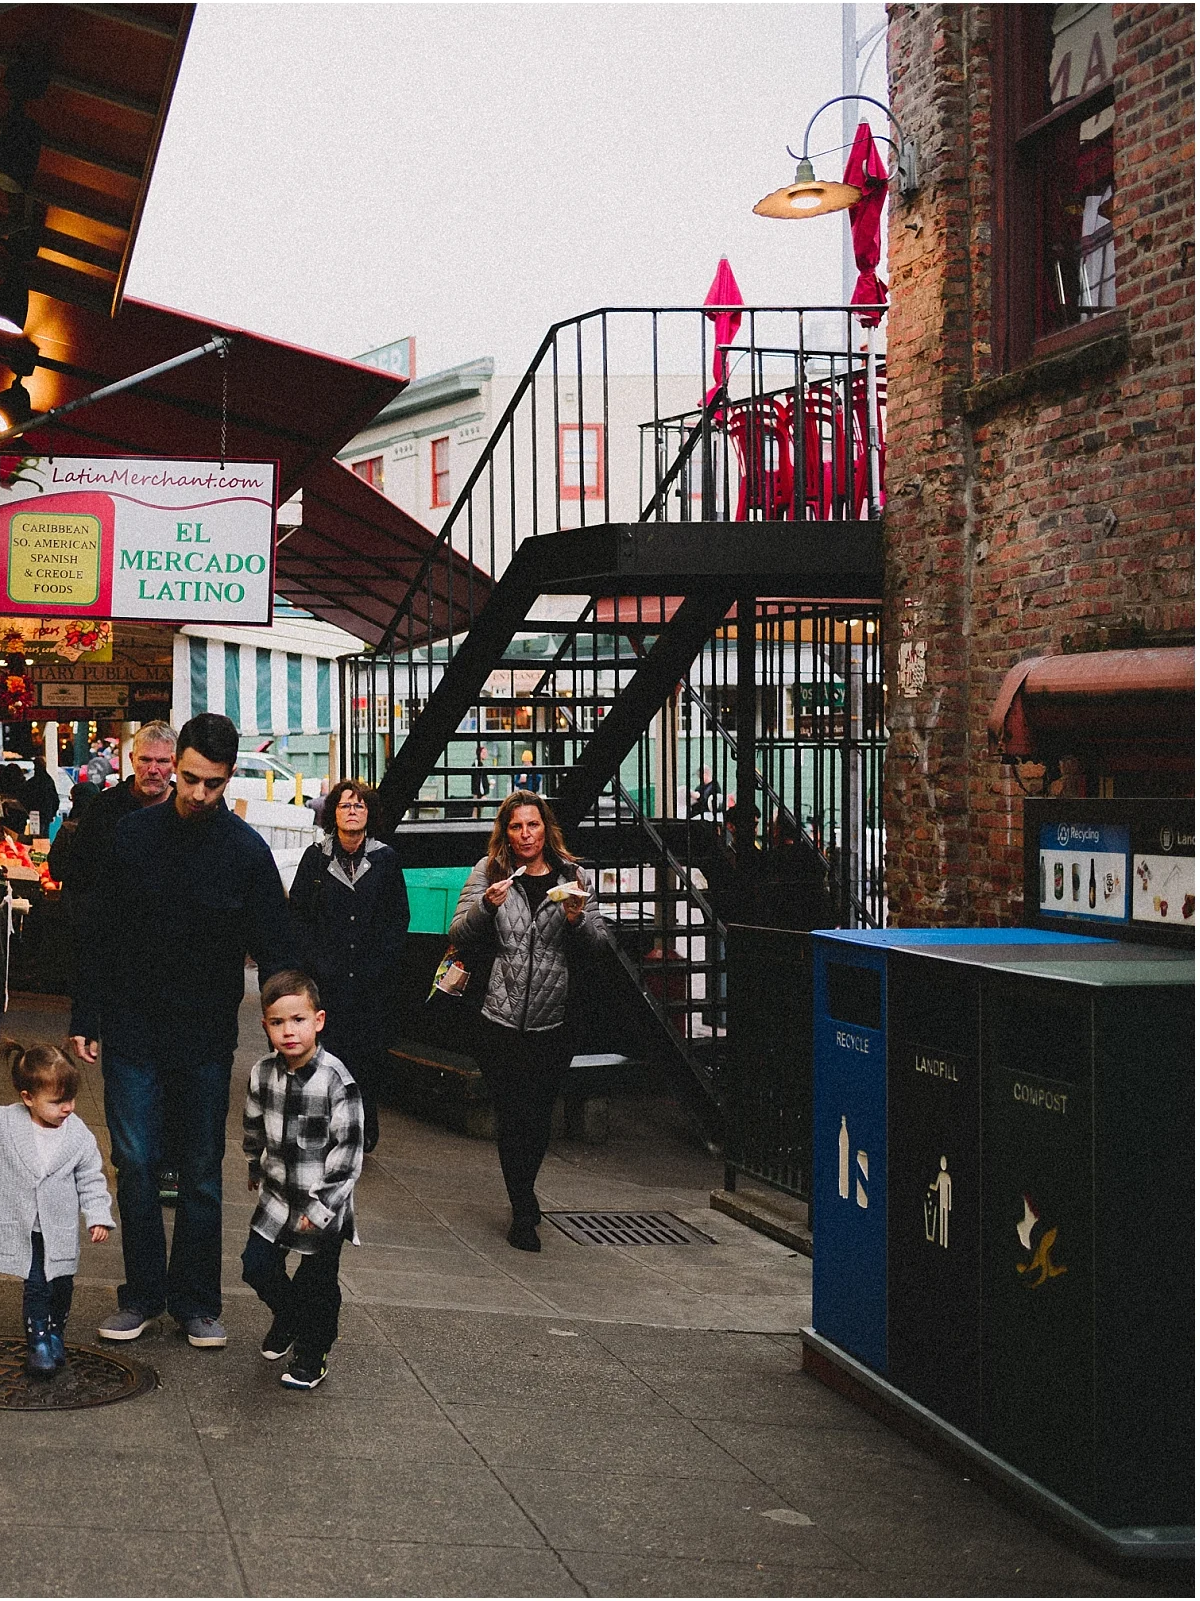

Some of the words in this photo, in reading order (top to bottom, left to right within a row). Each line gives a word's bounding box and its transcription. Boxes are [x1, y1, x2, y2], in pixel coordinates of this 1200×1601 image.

[52, 467, 264, 489] LatinMerchant.com
[22, 523, 89, 534] CARIBBEAN
[176, 522, 211, 543] EL
[13, 538, 30, 547] SO.
[34, 539, 97, 549] AMERICAN
[30, 553, 78, 564] SPANISH
[119, 549, 266, 574] MERCADO
[24, 568, 32, 577] &
[36, 569, 83, 579] CREOLE
[33, 584, 73, 593] FOODS
[138, 579, 245, 603] LATINO
[82, 667, 139, 680] PUBLIC
[1070, 826, 1099, 843] Recycling
[836, 1031, 869, 1053] RECYCLE
[915, 1055, 958, 1082] LANDFILL
[1013, 1083, 1068, 1114] COMPOST
